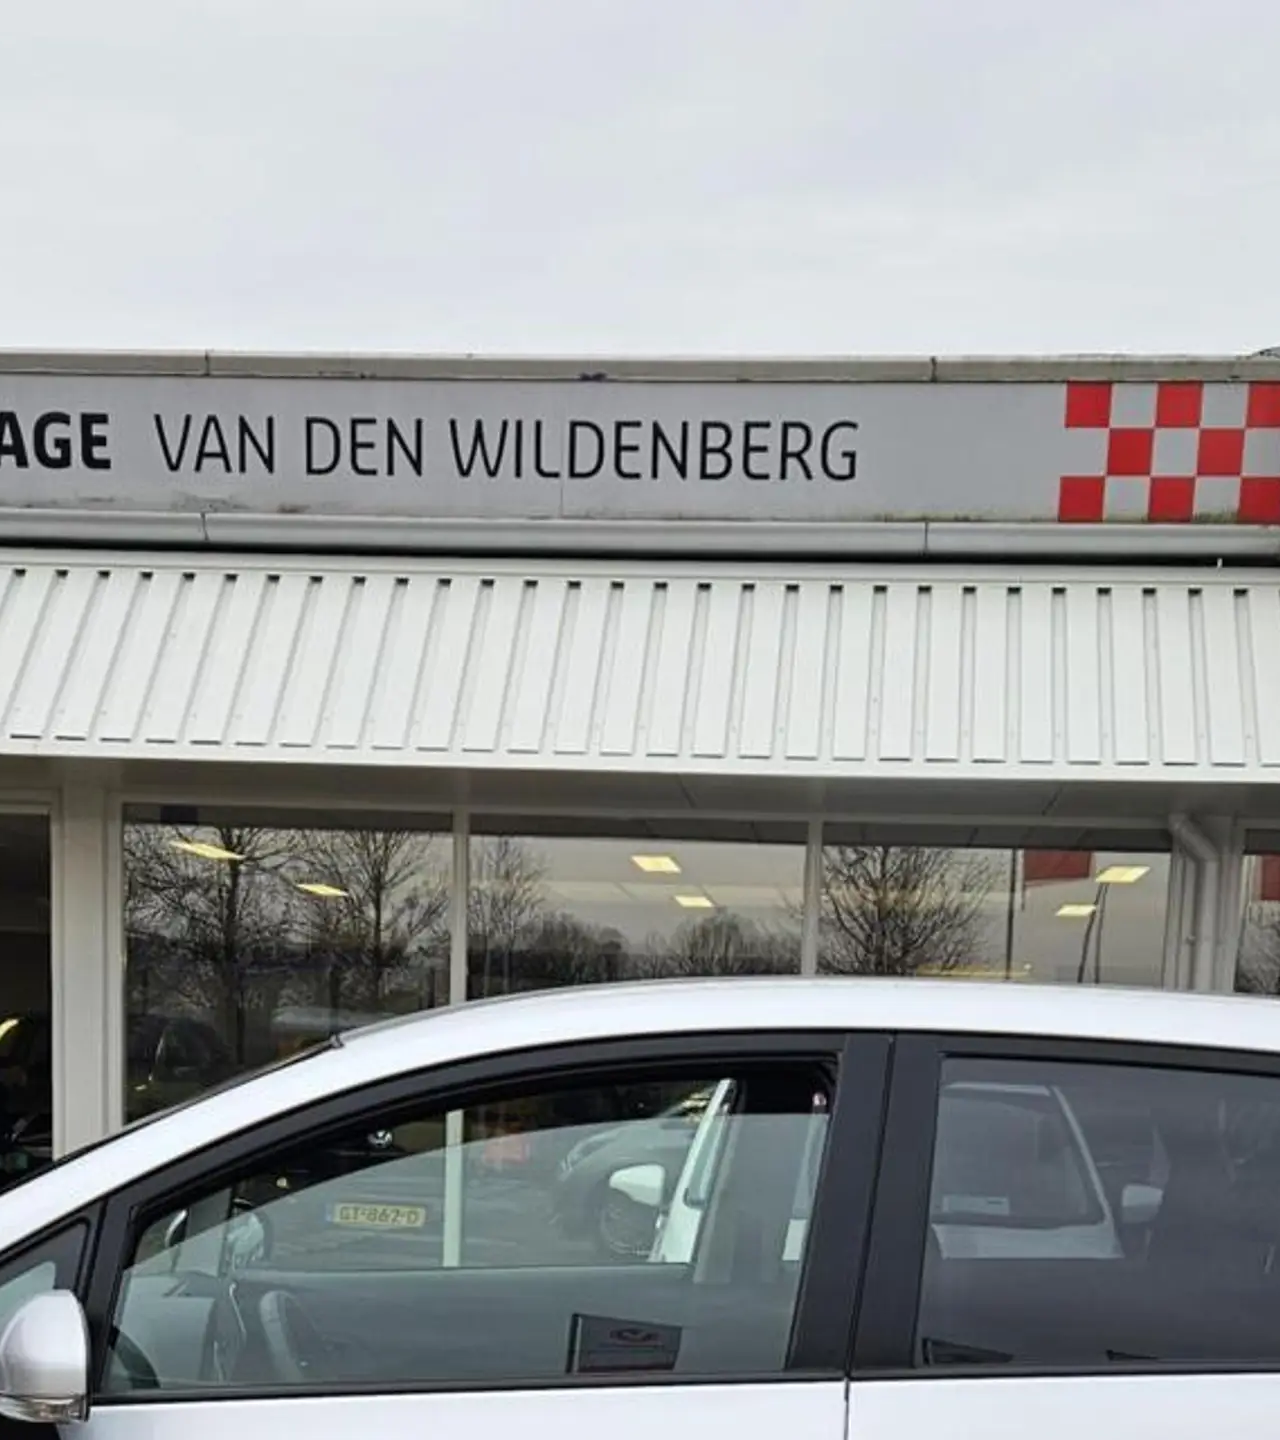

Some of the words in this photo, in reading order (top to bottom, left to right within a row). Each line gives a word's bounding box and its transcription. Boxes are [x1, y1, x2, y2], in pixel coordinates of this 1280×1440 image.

[152, 414, 276, 475] VAN
[304, 416, 424, 478] DEN
[448, 418, 860, 482] WILDENBERG
